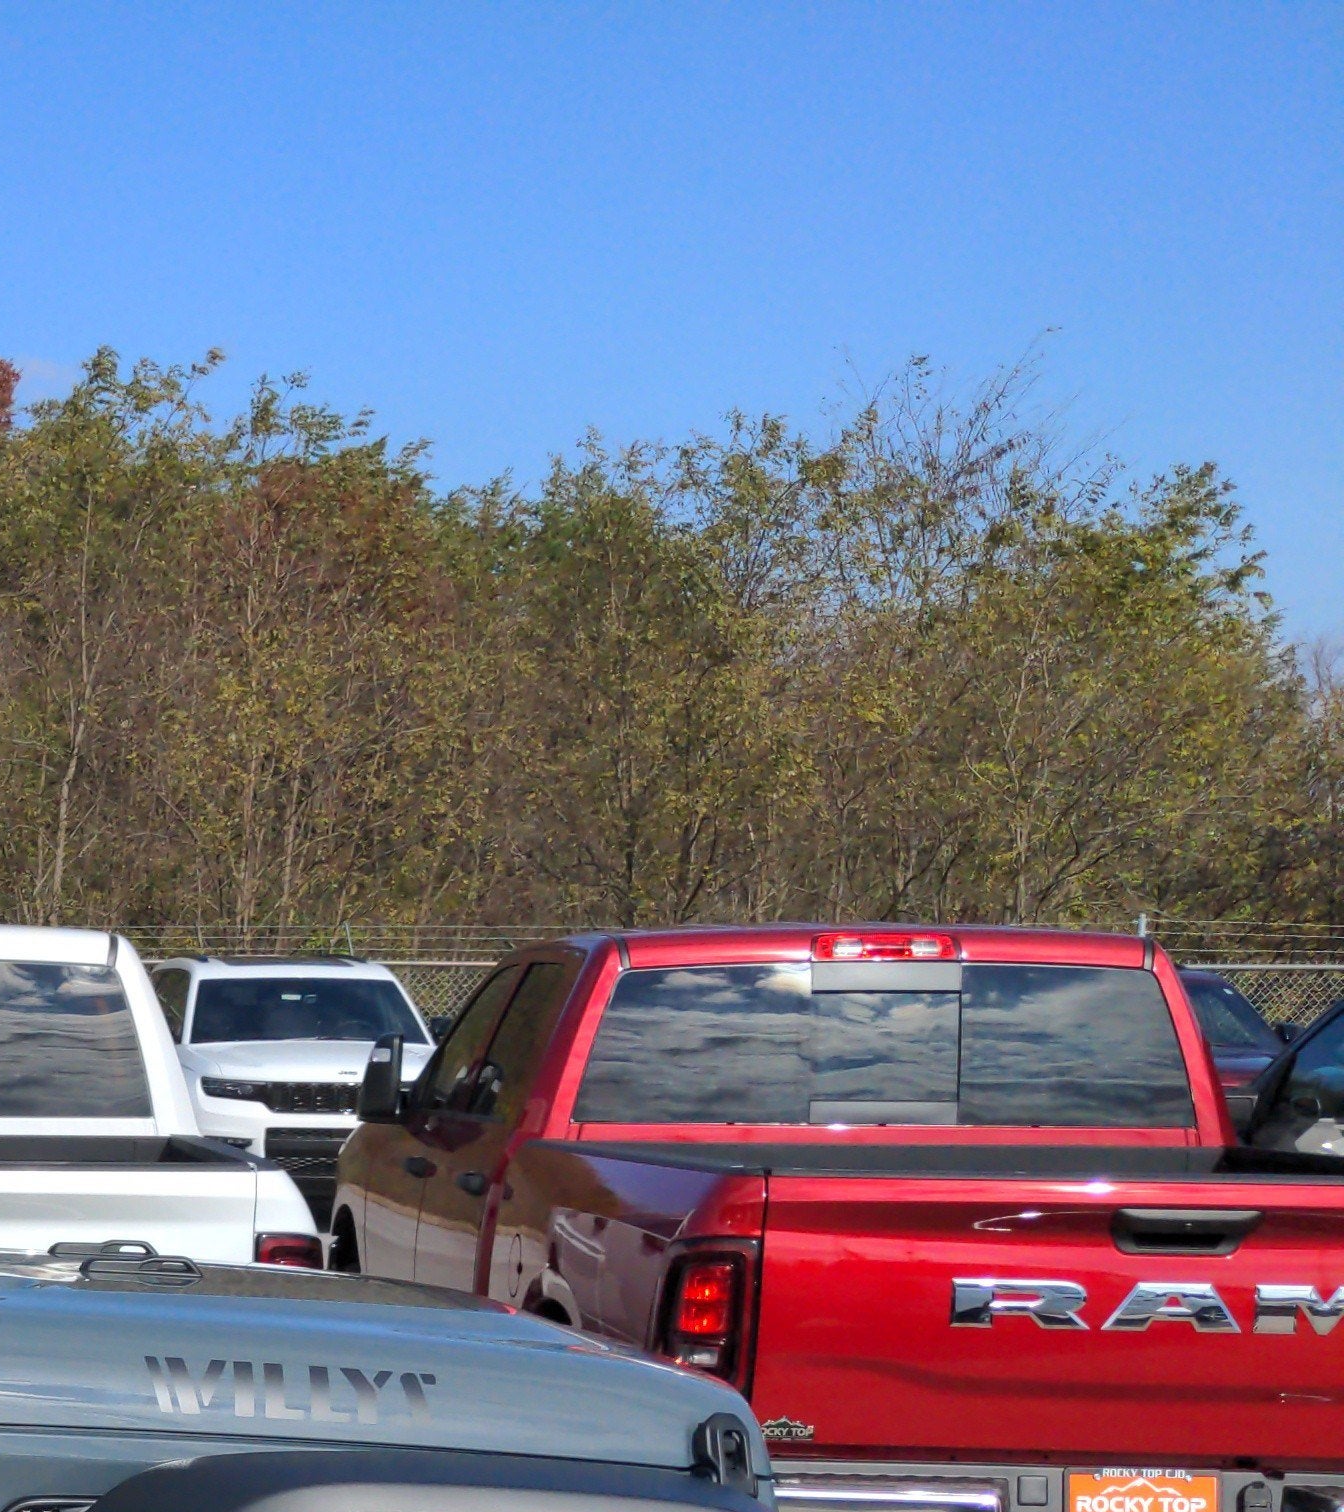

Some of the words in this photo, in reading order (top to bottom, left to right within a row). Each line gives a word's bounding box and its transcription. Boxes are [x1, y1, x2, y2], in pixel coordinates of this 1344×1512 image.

[950, 1277, 1344, 1336] RAM
[144, 1355, 437, 1424] WILLYS
[791, 1426, 814, 1436] TOP
[1102, 1468, 1137, 1478] ROCKY
[1142, 1469, 1162, 1479] TOP
[1165, 1469, 1186, 1479] CJD
[1075, 1495, 1154, 1512] ROCKY
